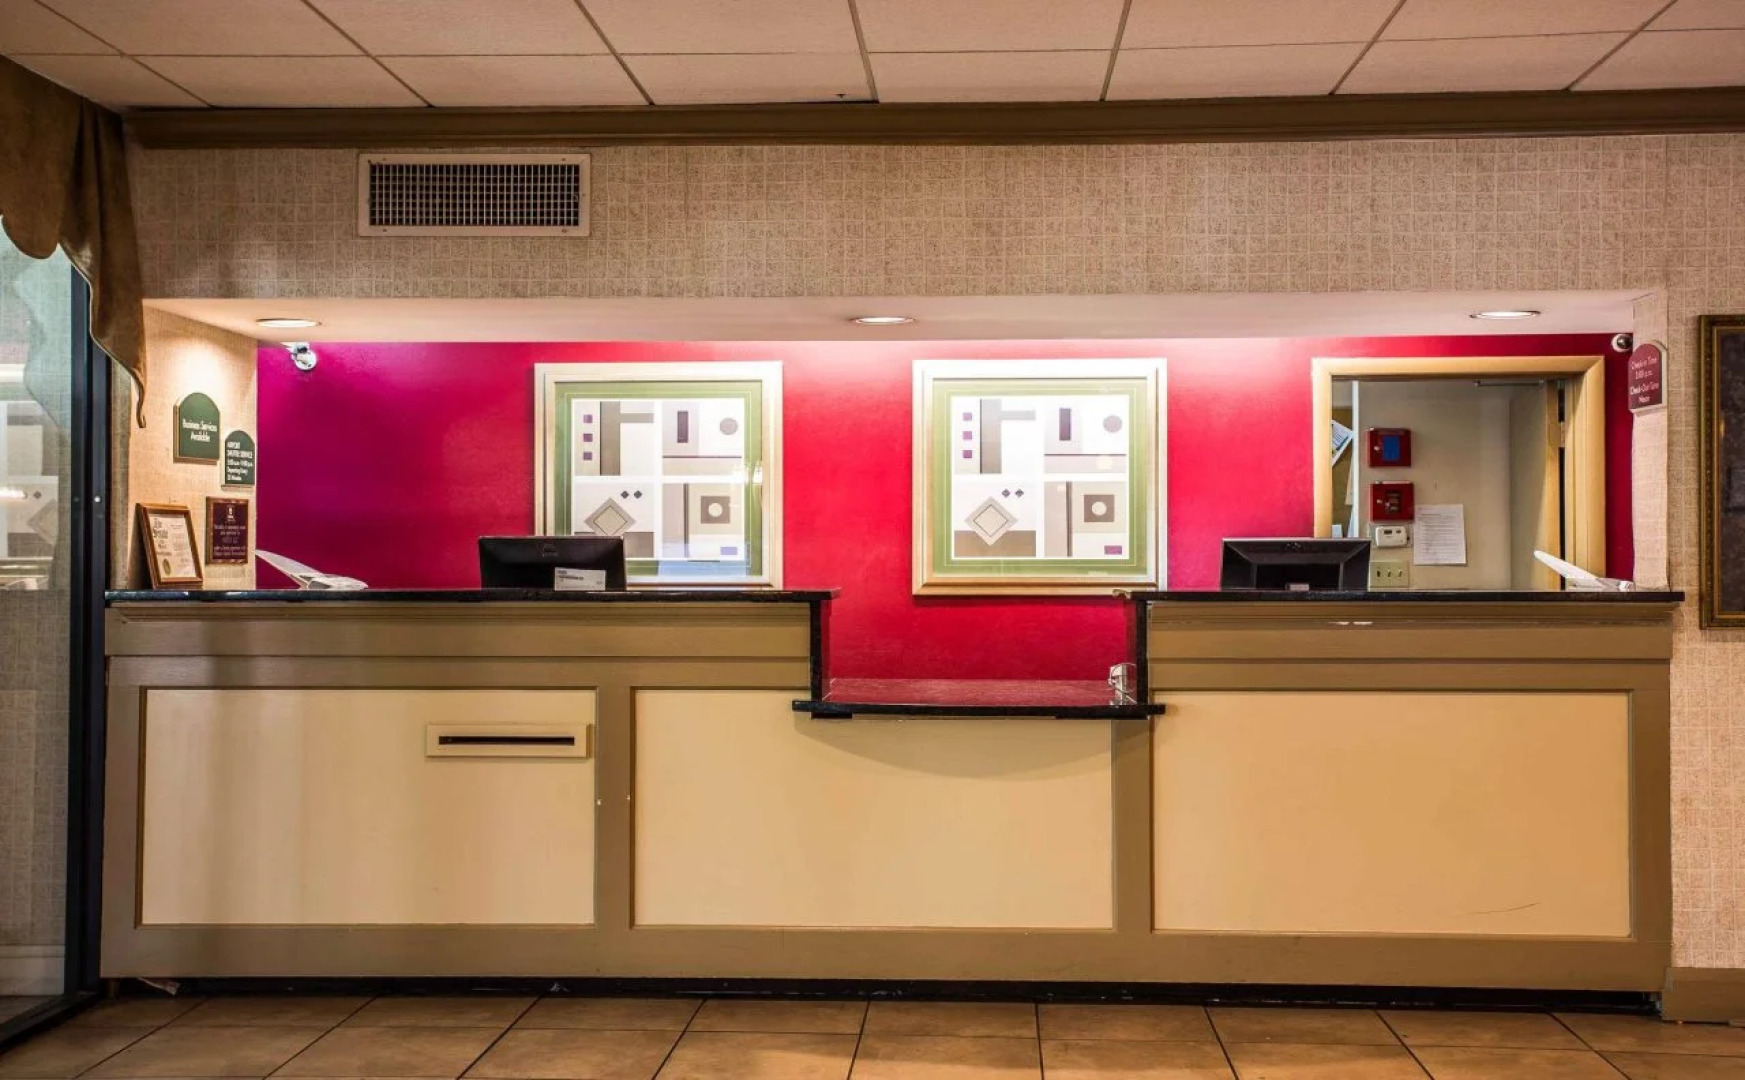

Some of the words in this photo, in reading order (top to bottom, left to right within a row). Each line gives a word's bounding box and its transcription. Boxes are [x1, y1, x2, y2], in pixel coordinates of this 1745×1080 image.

[182, 418, 200, 430] Business
[200, 420, 218, 433] Services
[190, 431, 211, 442] Available
